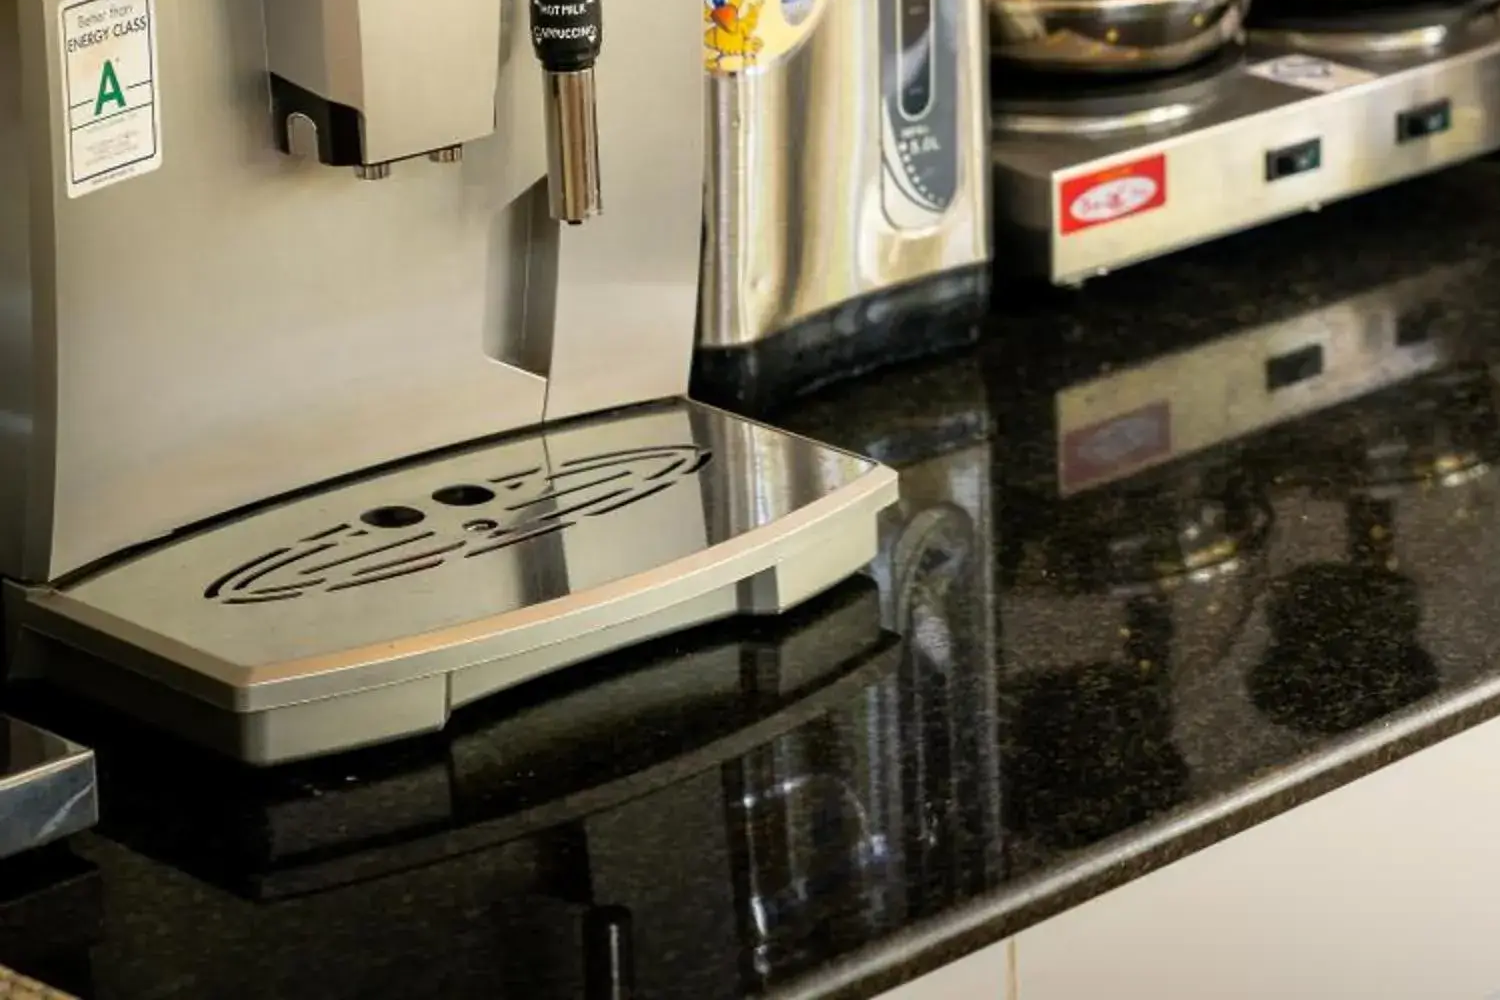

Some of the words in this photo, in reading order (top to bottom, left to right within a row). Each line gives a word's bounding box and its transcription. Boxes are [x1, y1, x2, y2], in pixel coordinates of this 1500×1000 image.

[541, 4, 560, 16] HOT
[561, 3, 587, 15] MILK
[67, 28, 111, 53] ENERGY
[113, 15, 148, 37] CLASS
[534, 25, 598, 39] CAPPUCCINO
